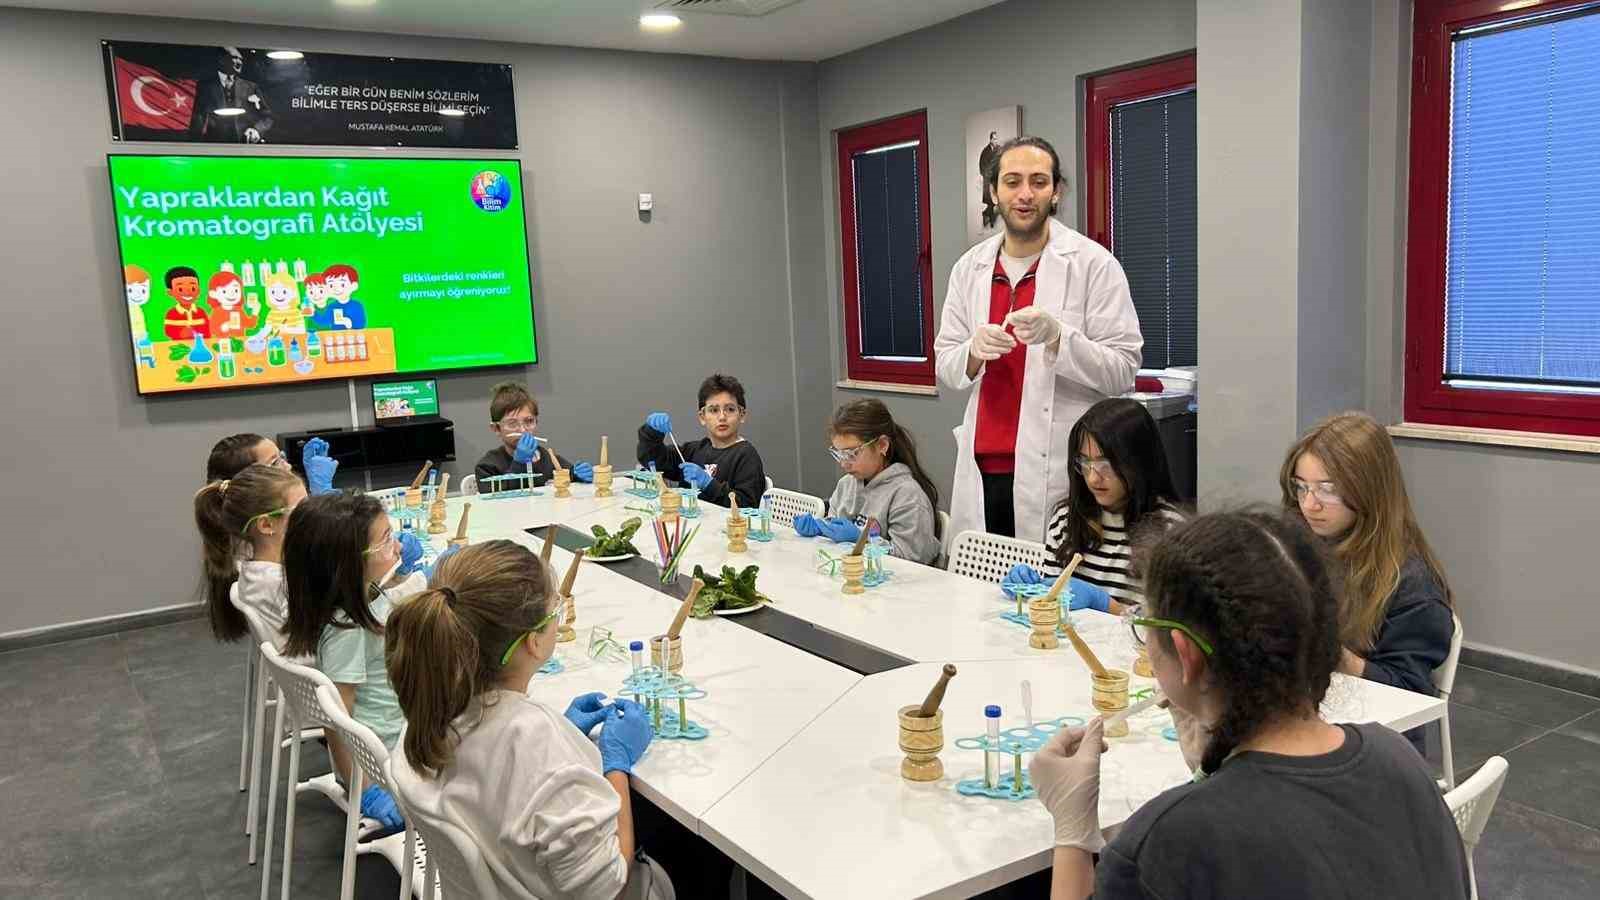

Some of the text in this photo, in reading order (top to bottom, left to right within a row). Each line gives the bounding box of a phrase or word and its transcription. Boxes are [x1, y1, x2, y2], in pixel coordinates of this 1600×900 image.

[341, 85, 360, 97] BİR
[362, 86, 388, 98] GÜN
[390, 88, 425, 99] BENİM
[426, 89, 480, 102] SÖZLERİM
[291, 96, 338, 110] BİLİMLE
[340, 100, 369, 111] TERS
[370, 100, 420, 114] DÜŞERSE
[348, 123, 444, 132] MUSTAFA KEMAL ATATÜRK
[119, 185, 390, 214] Yapraklardan Kağıt
[124, 210, 424, 240] Kromatografi Atölyesi
[402, 270, 505, 283] Bitkilerdeki renkleri
[399, 287, 445, 302] ayırmayı
